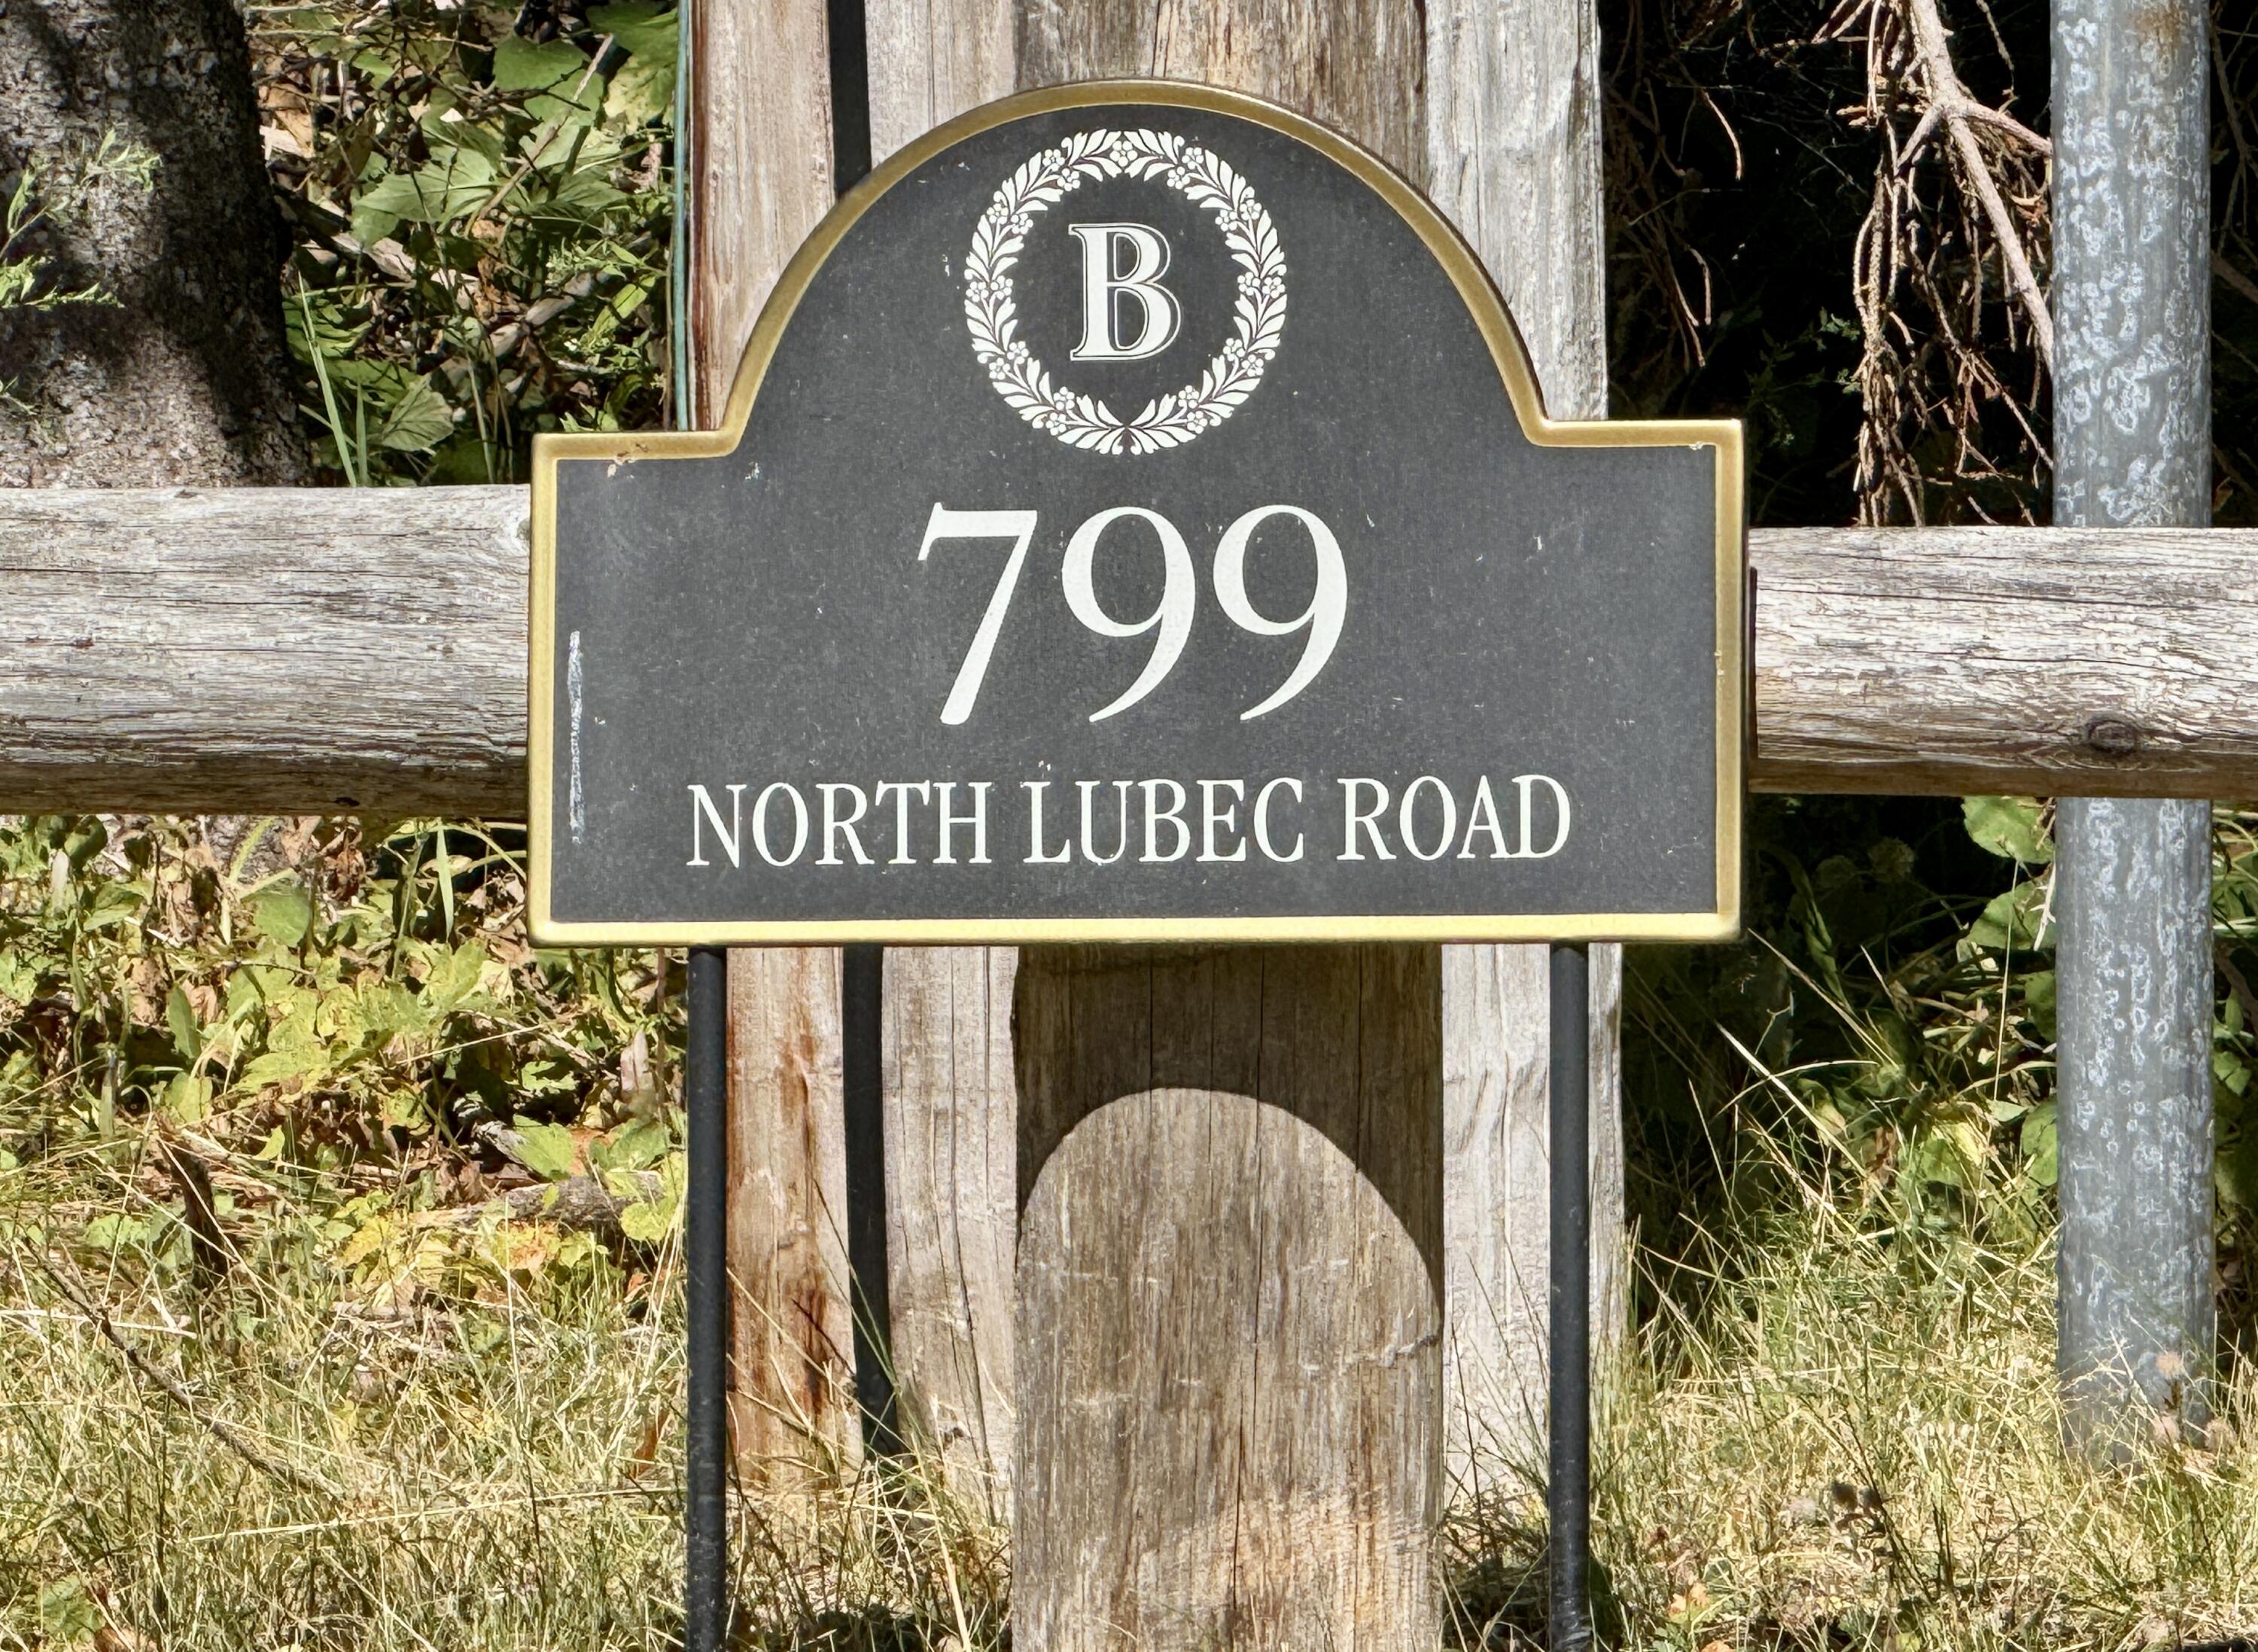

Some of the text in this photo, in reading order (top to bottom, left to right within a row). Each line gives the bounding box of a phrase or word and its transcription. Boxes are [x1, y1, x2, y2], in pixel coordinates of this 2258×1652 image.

[1067, 222, 1182, 362] B
[917, 501, 1348, 726] 799
[686, 774, 1571, 869] NORTH LUBEC ROAD
